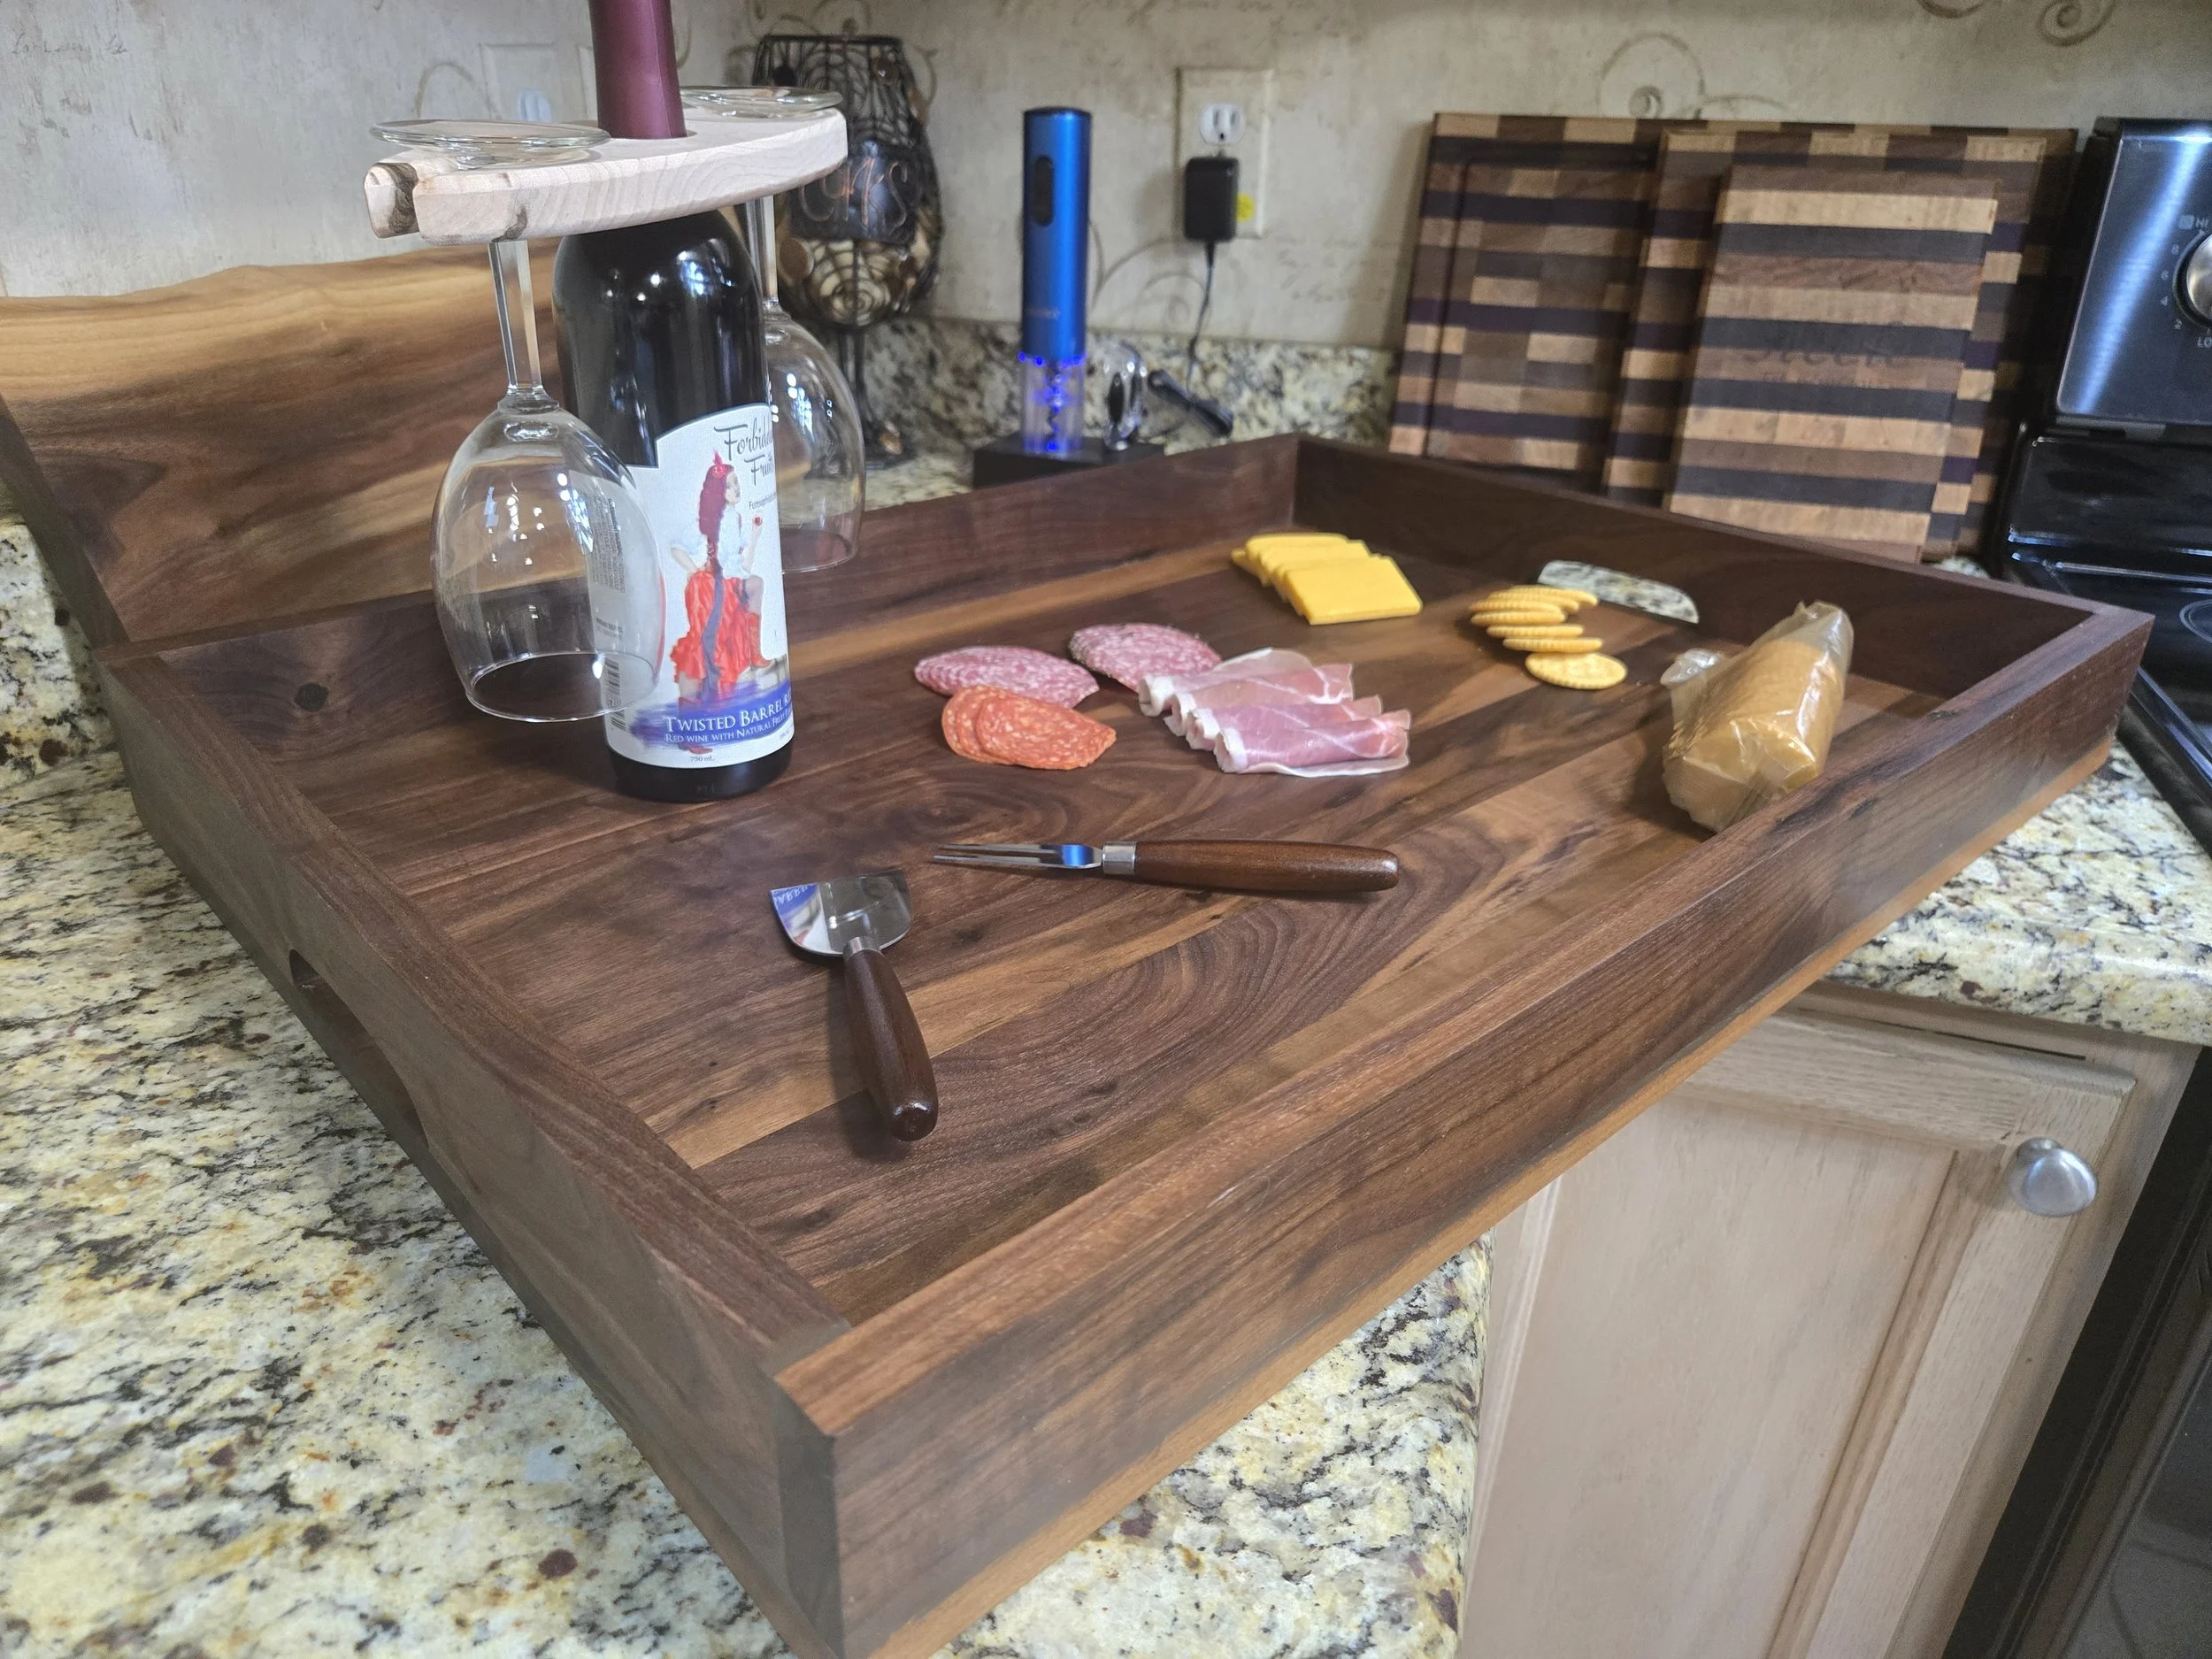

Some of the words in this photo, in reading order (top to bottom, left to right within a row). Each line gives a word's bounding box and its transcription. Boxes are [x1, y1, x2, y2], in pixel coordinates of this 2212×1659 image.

[663, 716, 735, 732] TWISTED
[740, 698, 784, 727] BARREL
[711, 731, 734, 741] WITH
[736, 721, 772, 740] NATURAL
